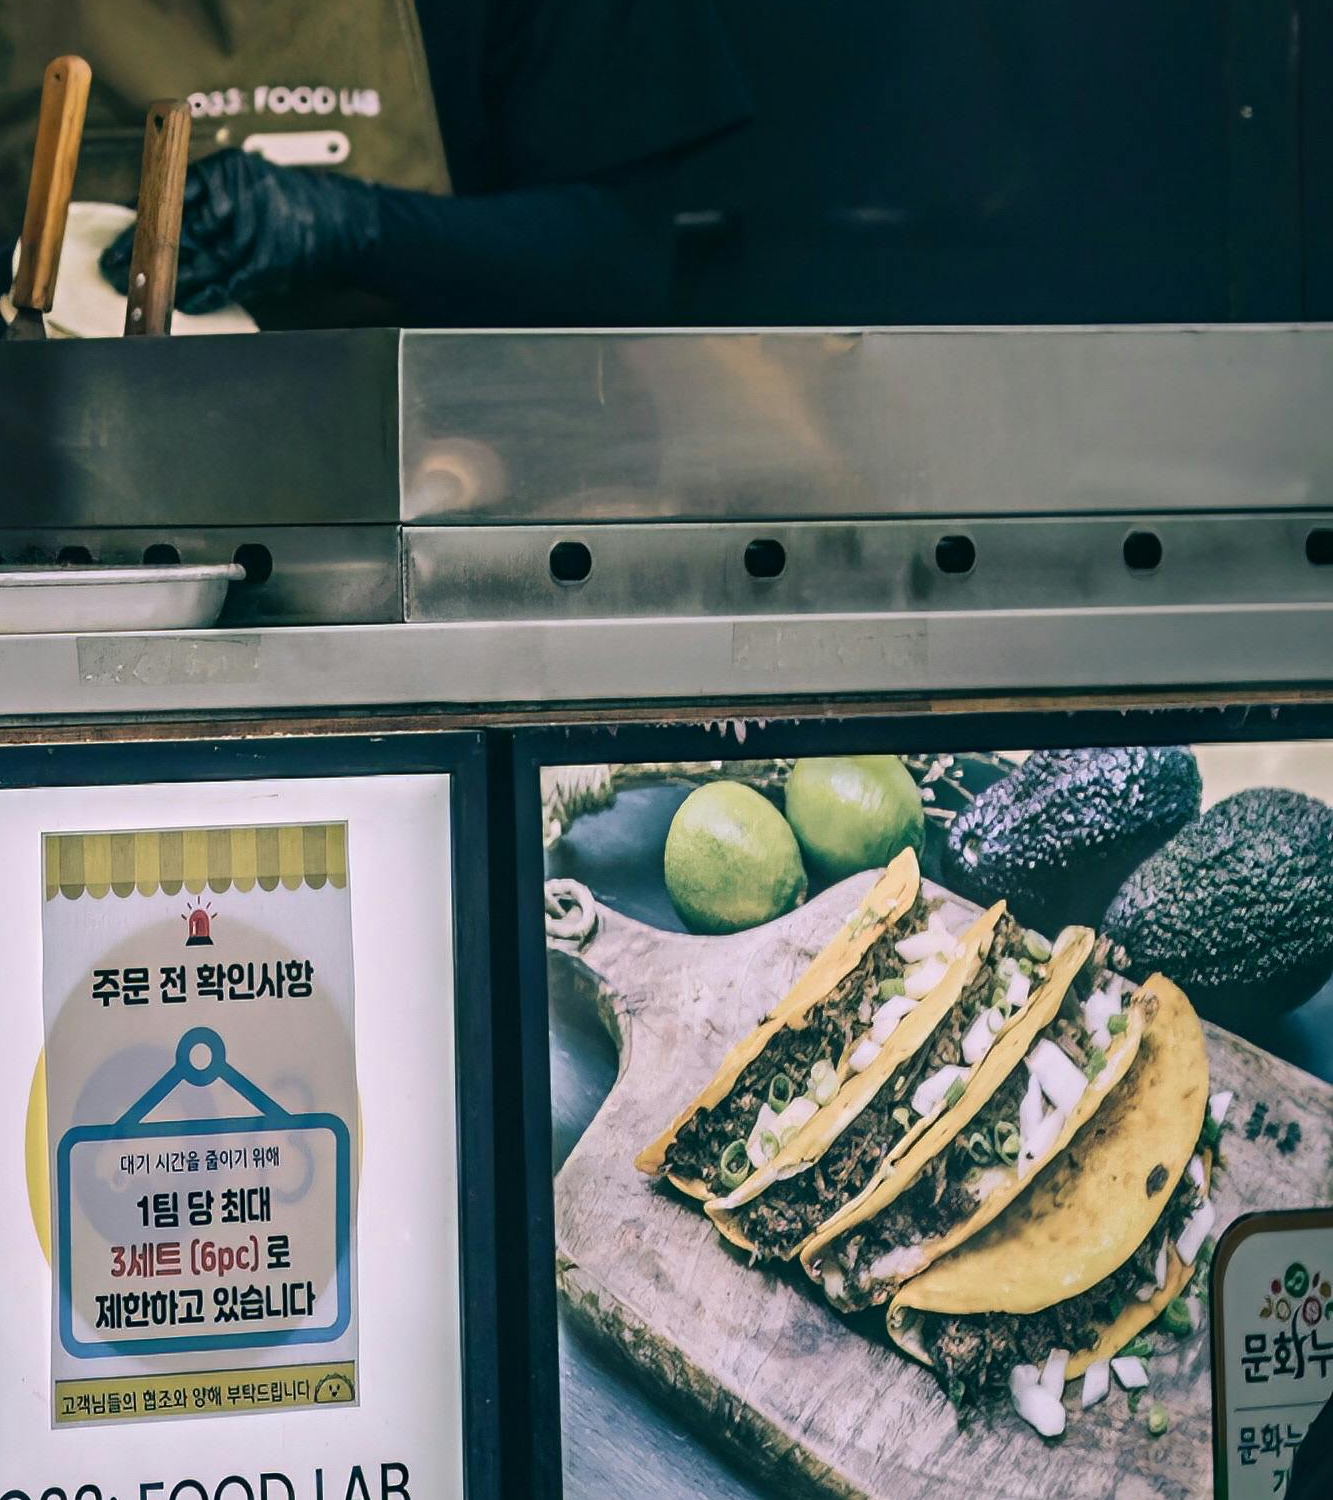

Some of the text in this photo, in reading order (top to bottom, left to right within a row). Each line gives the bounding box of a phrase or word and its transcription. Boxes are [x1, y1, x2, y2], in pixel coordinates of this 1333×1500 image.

[91, 959, 315, 1007] 주문 전 확인사항
[120, 1146, 280, 1175] 대기 시간을 줄이기 위해
[136, 1185, 272, 1229] 1팀 당 최대
[110, 1234, 292, 1278] 3세트 (6pc) 로
[94, 1280, 316, 1330] 제한하고 있습니다
[60, 1378, 311, 1416] 고객님들의 협조와 양해 부탁드립니다
